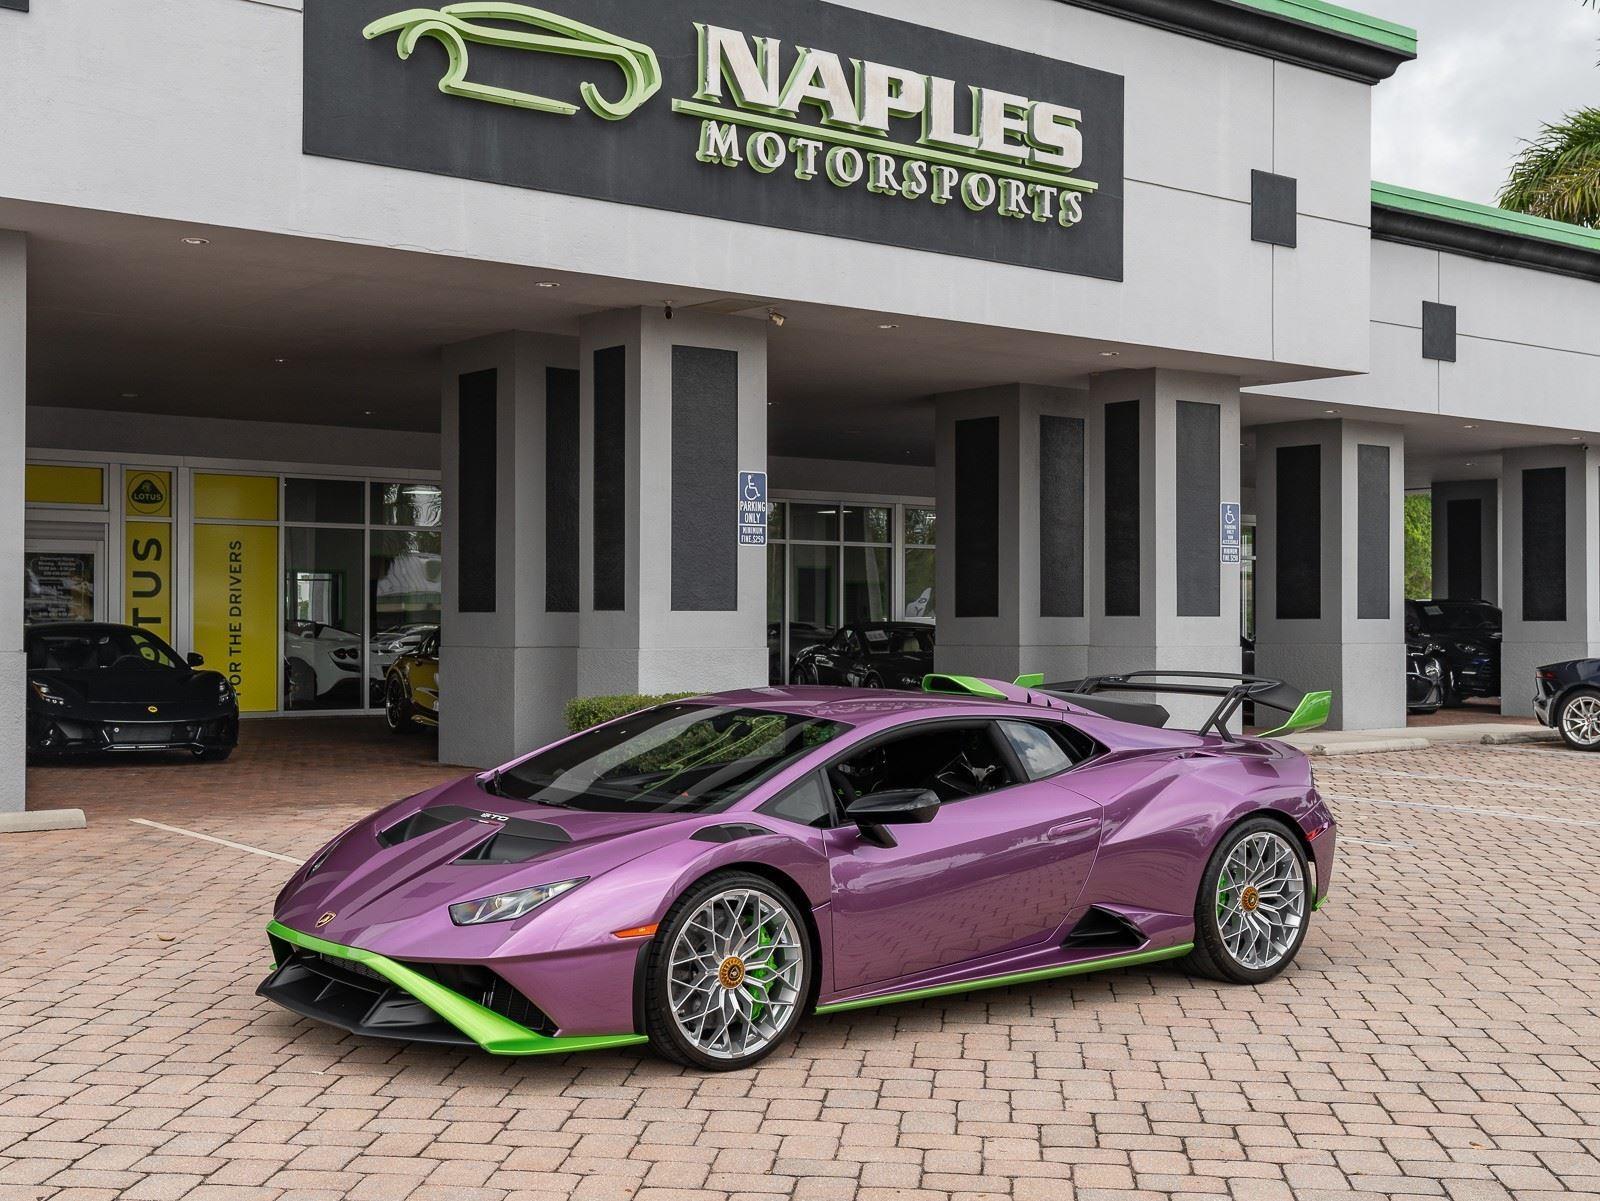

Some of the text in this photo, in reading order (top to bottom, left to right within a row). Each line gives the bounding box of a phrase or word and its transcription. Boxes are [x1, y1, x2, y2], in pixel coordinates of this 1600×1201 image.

[692, 22, 1083, 173] NAPLES
[695, 119, 1083, 227] MOTORSPORTS
[134, 493, 162, 501] LOTUS
[740, 501, 766, 512] PARKING
[742, 527, 763, 535] MINIMUM
[744, 512, 761, 524] ONLY
[132, 537, 163, 629] TUS
[229, 540, 242, 617] DRIVERS
[229, 622, 242, 657] THE
